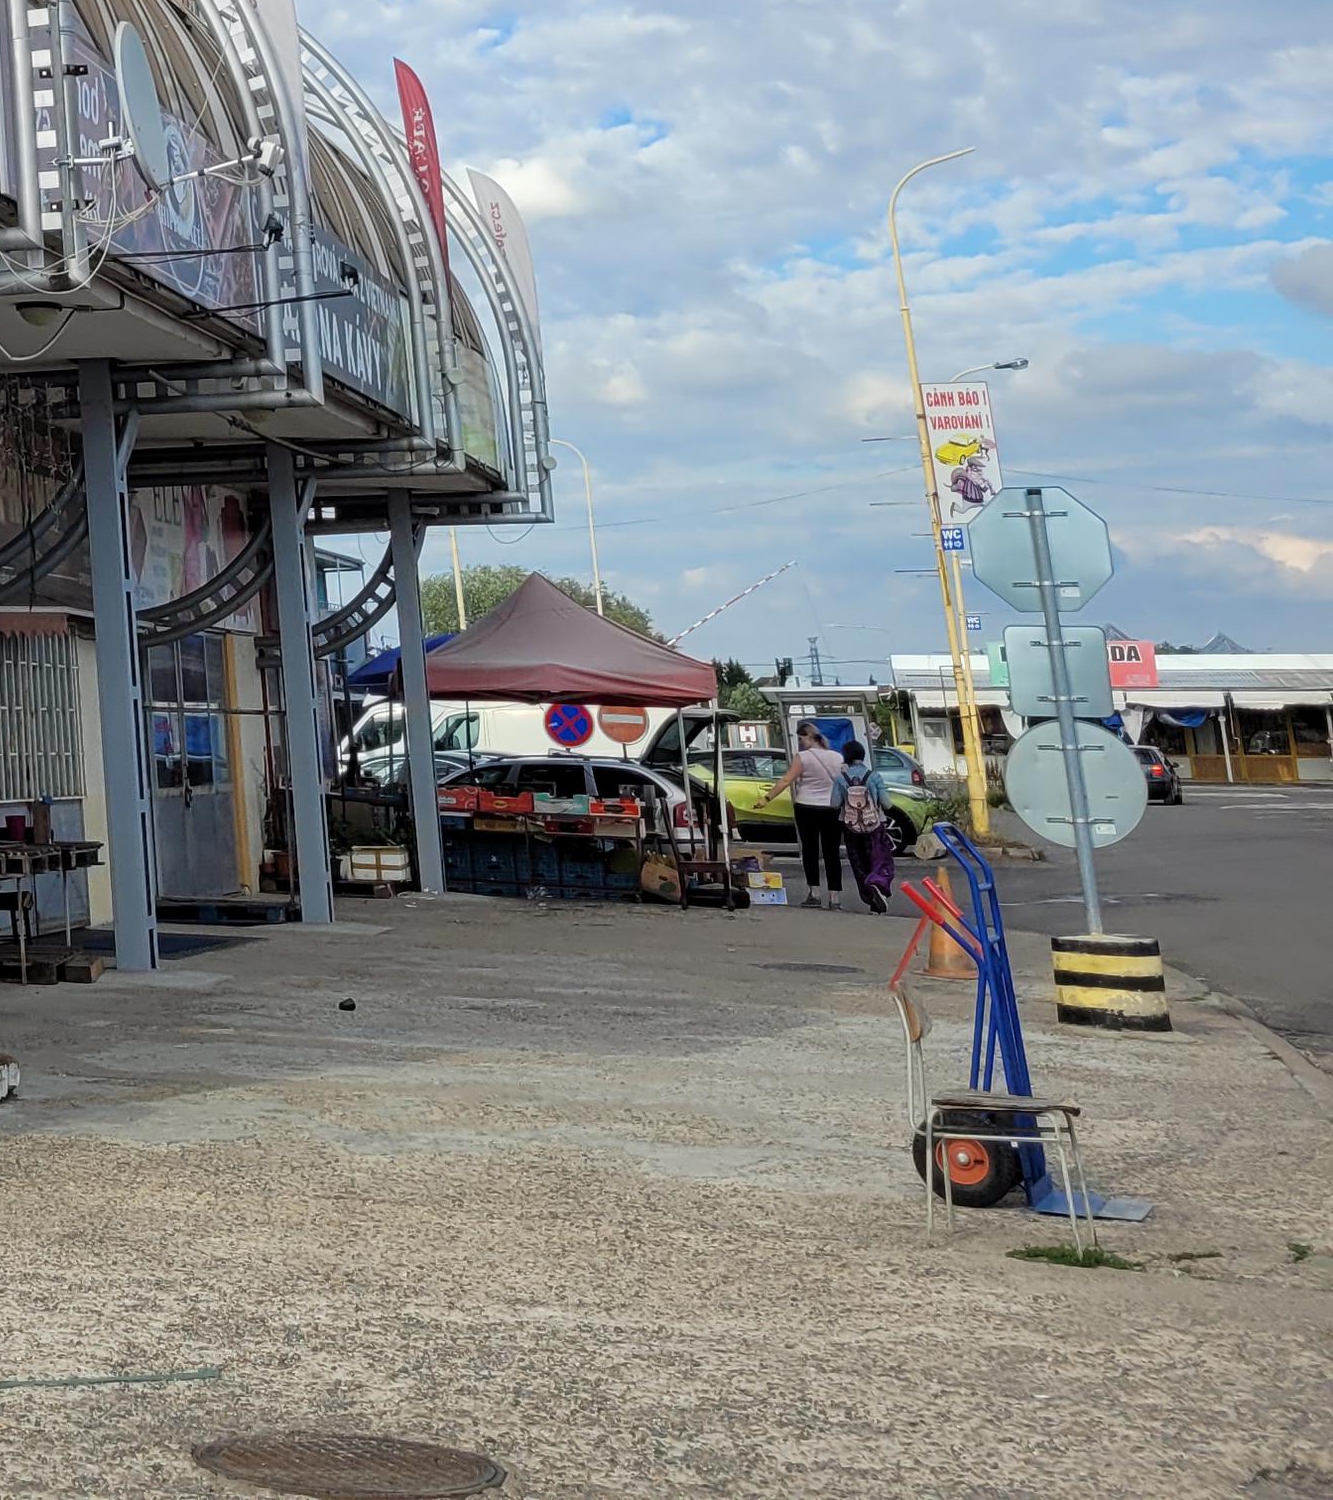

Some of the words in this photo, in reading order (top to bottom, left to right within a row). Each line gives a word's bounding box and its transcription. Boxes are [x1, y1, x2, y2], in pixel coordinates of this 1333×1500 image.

[344, 313, 382, 391] KÁVY
[930, 412, 983, 431] VAROVÁNÍ
[942, 529, 961, 539] WC
[1108, 645, 1141, 662] DA
